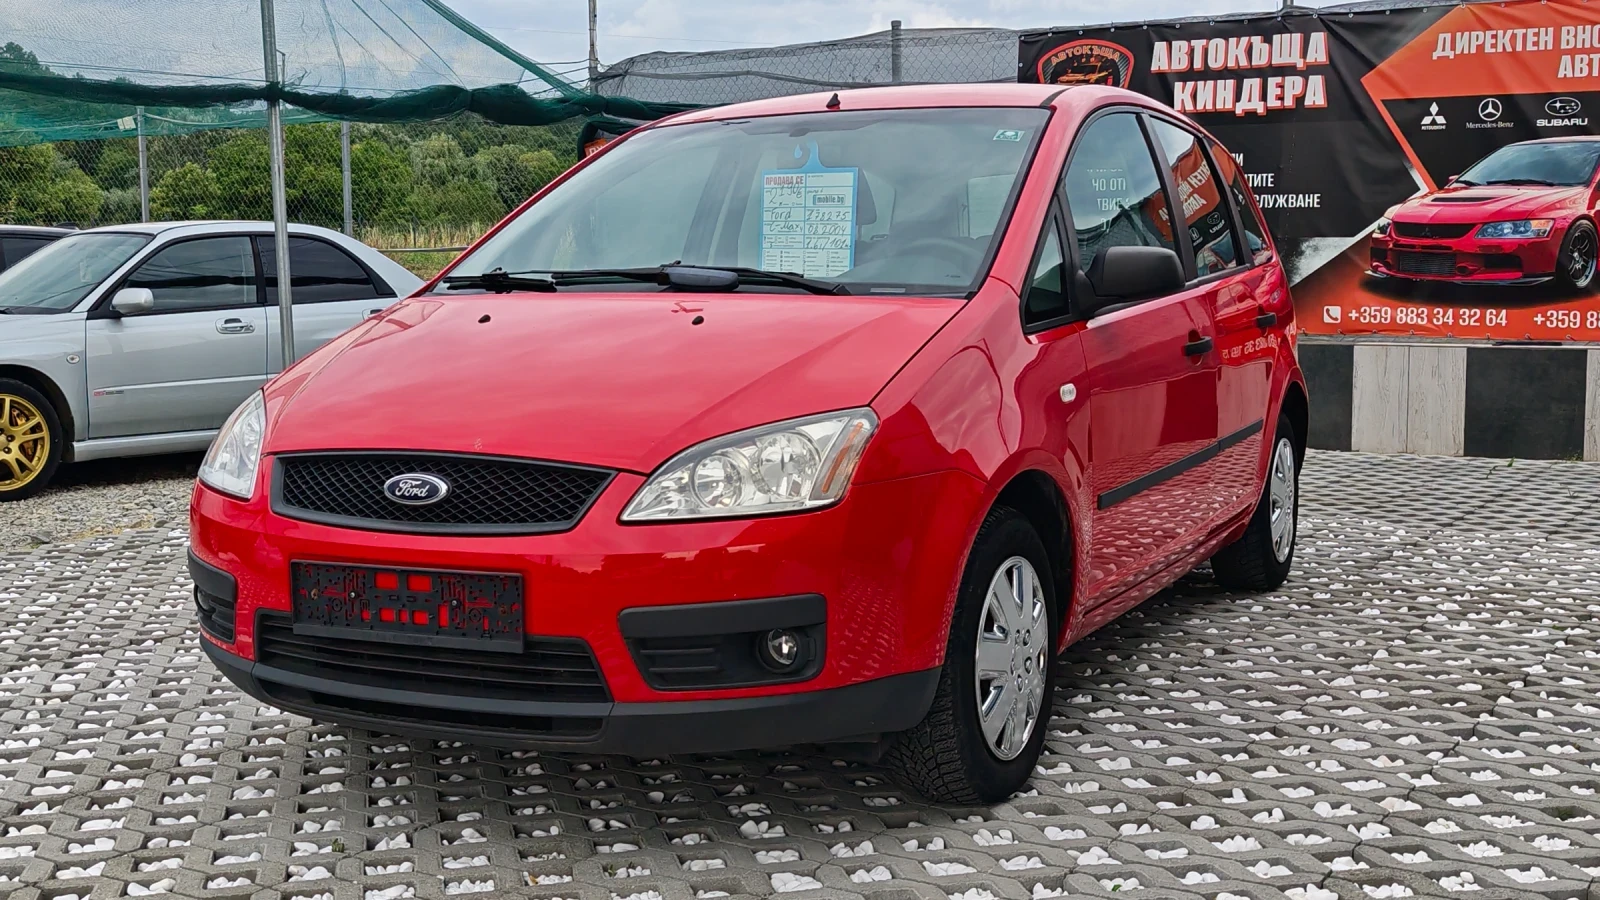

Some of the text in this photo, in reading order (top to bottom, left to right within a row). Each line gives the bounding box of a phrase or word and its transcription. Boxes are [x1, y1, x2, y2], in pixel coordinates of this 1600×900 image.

[1151, 32, 1329, 73] АВТОКЪЩА
[1432, 27, 1554, 60] ДИРЕКТЕН
[1050, 45, 1120, 65] АВТОКЪЩА
[1557, 53, 1600, 78] АВТ
[1173, 75, 1328, 116] КИНДЕРА
[1465, 121, 1514, 129] Mercedes-Benz
[1536, 118, 1588, 127] SUBARU
[1244, 173, 1275, 187] ТИТЕ
[816, 195, 845, 205] mobile.bg
[1348, 306, 1507, 327] +359 883 34 32 64
[1533, 310, 1600, 329] +359 8
[395, 479, 430, 497] Ford
